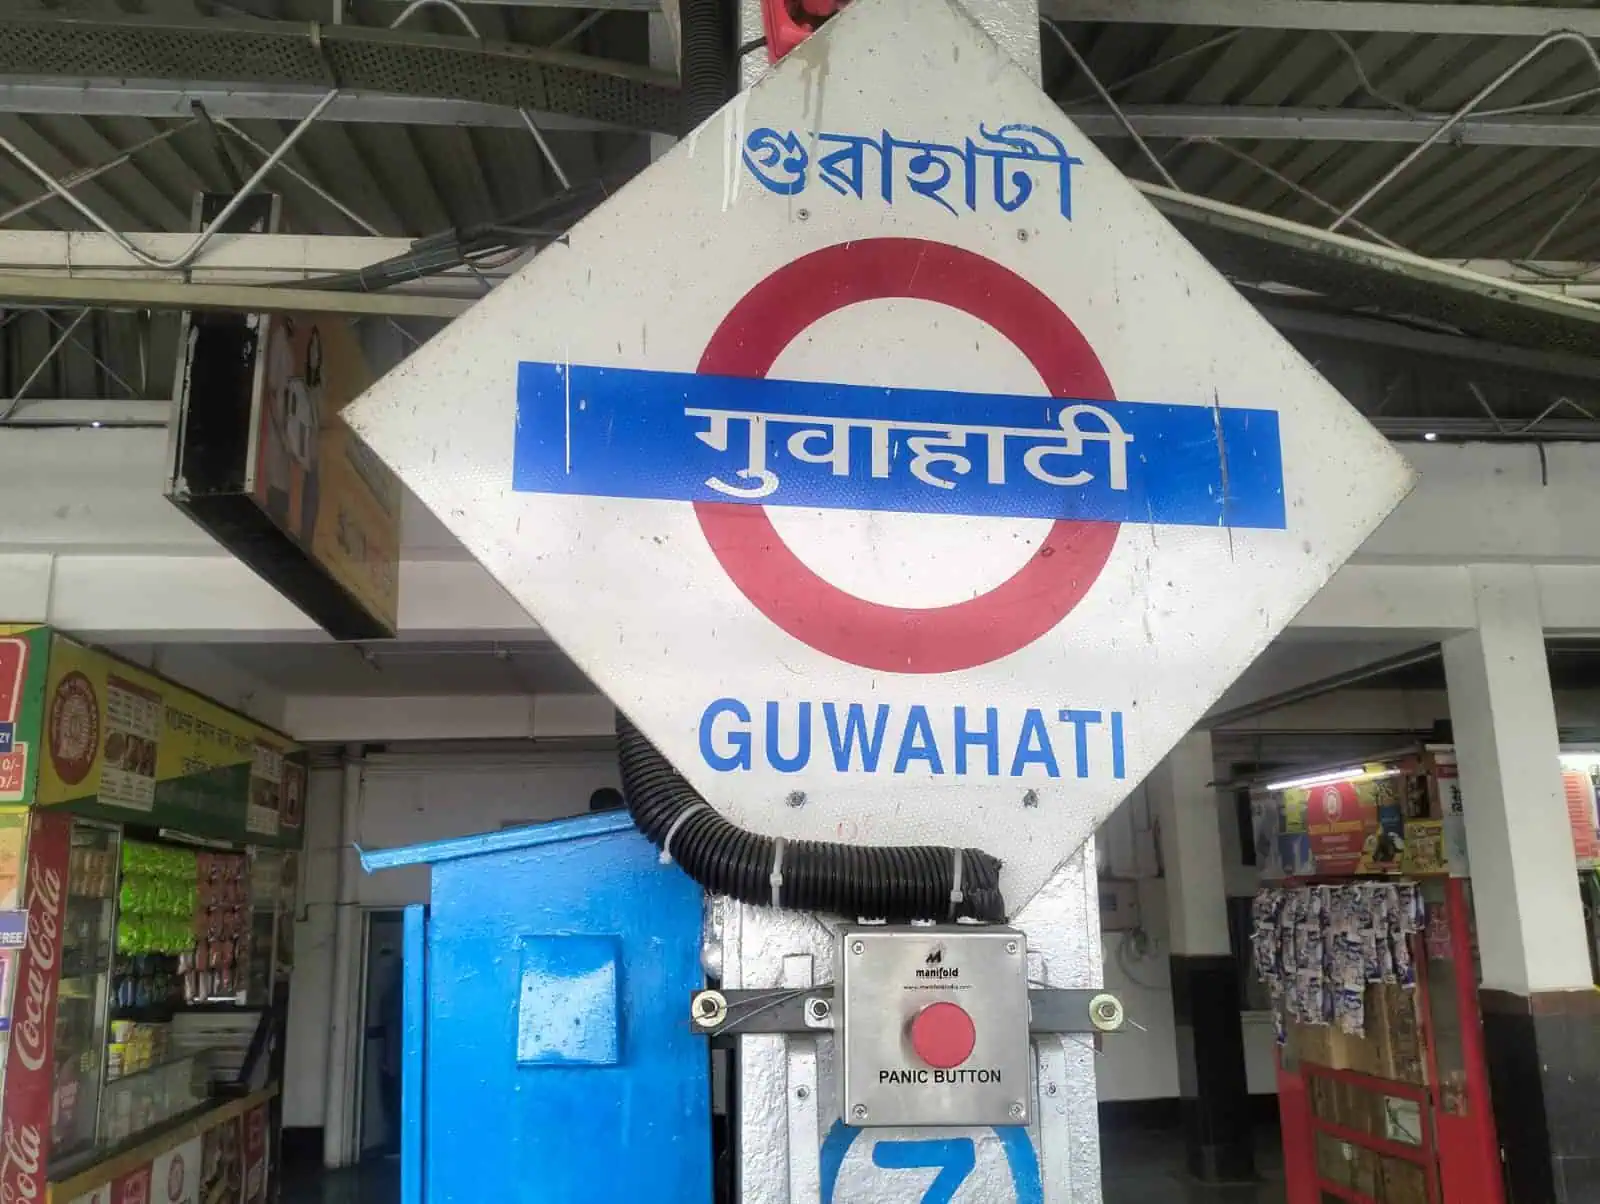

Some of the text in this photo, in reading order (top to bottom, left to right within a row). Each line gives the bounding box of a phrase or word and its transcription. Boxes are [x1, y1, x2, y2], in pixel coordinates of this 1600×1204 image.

[742, 121, 1084, 222] গুৱাহাটী
[684, 403, 1135, 498] गुवाहाटी
[699, 697, 1126, 779] GUWAHATI
[915, 967, 959, 979] manifold
[879, 1069, 1001, 1084] PANIC BUTTON
